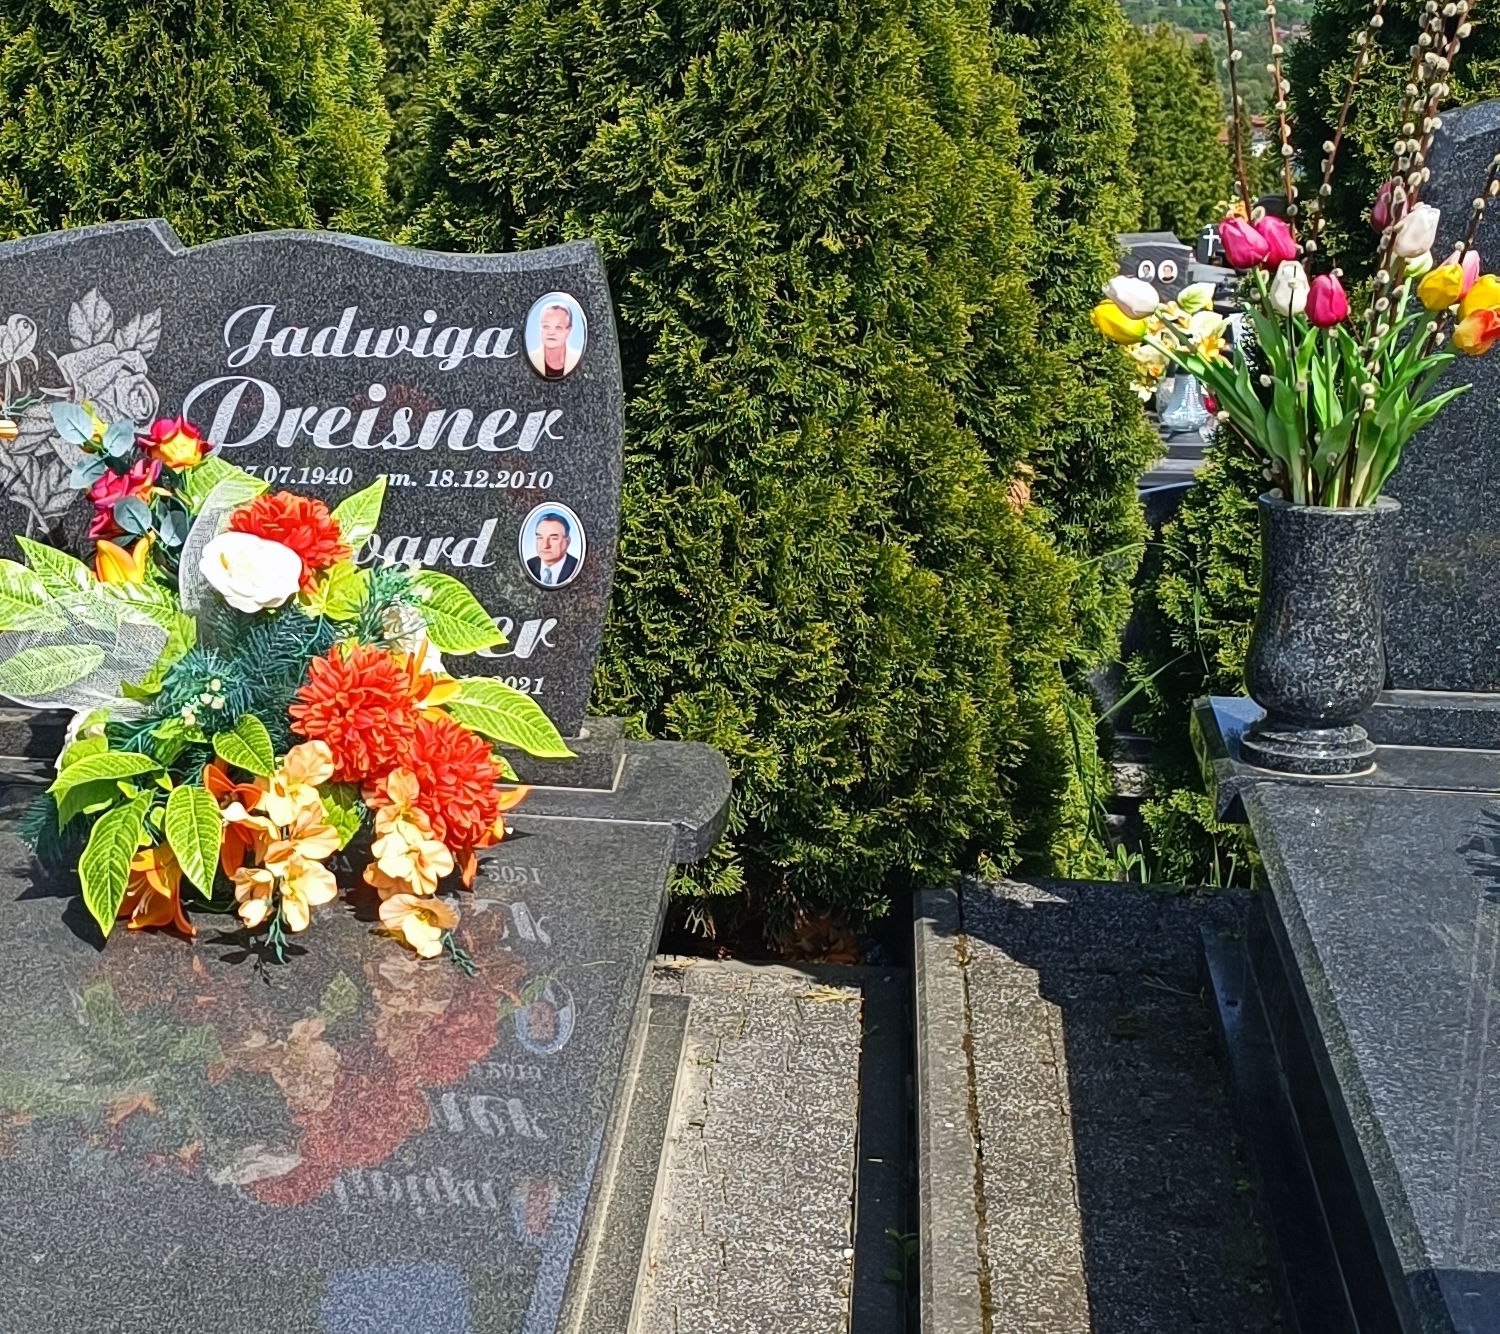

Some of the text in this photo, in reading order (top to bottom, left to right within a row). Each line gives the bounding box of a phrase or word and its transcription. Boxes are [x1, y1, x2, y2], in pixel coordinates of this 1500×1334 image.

[223, 304, 519, 371] Jadwiga
[182, 375, 564, 453] Dreisner
[233, 465, 555, 490] 707.1940 m. 18.12.2010
[352, 517, 499, 568] ward
